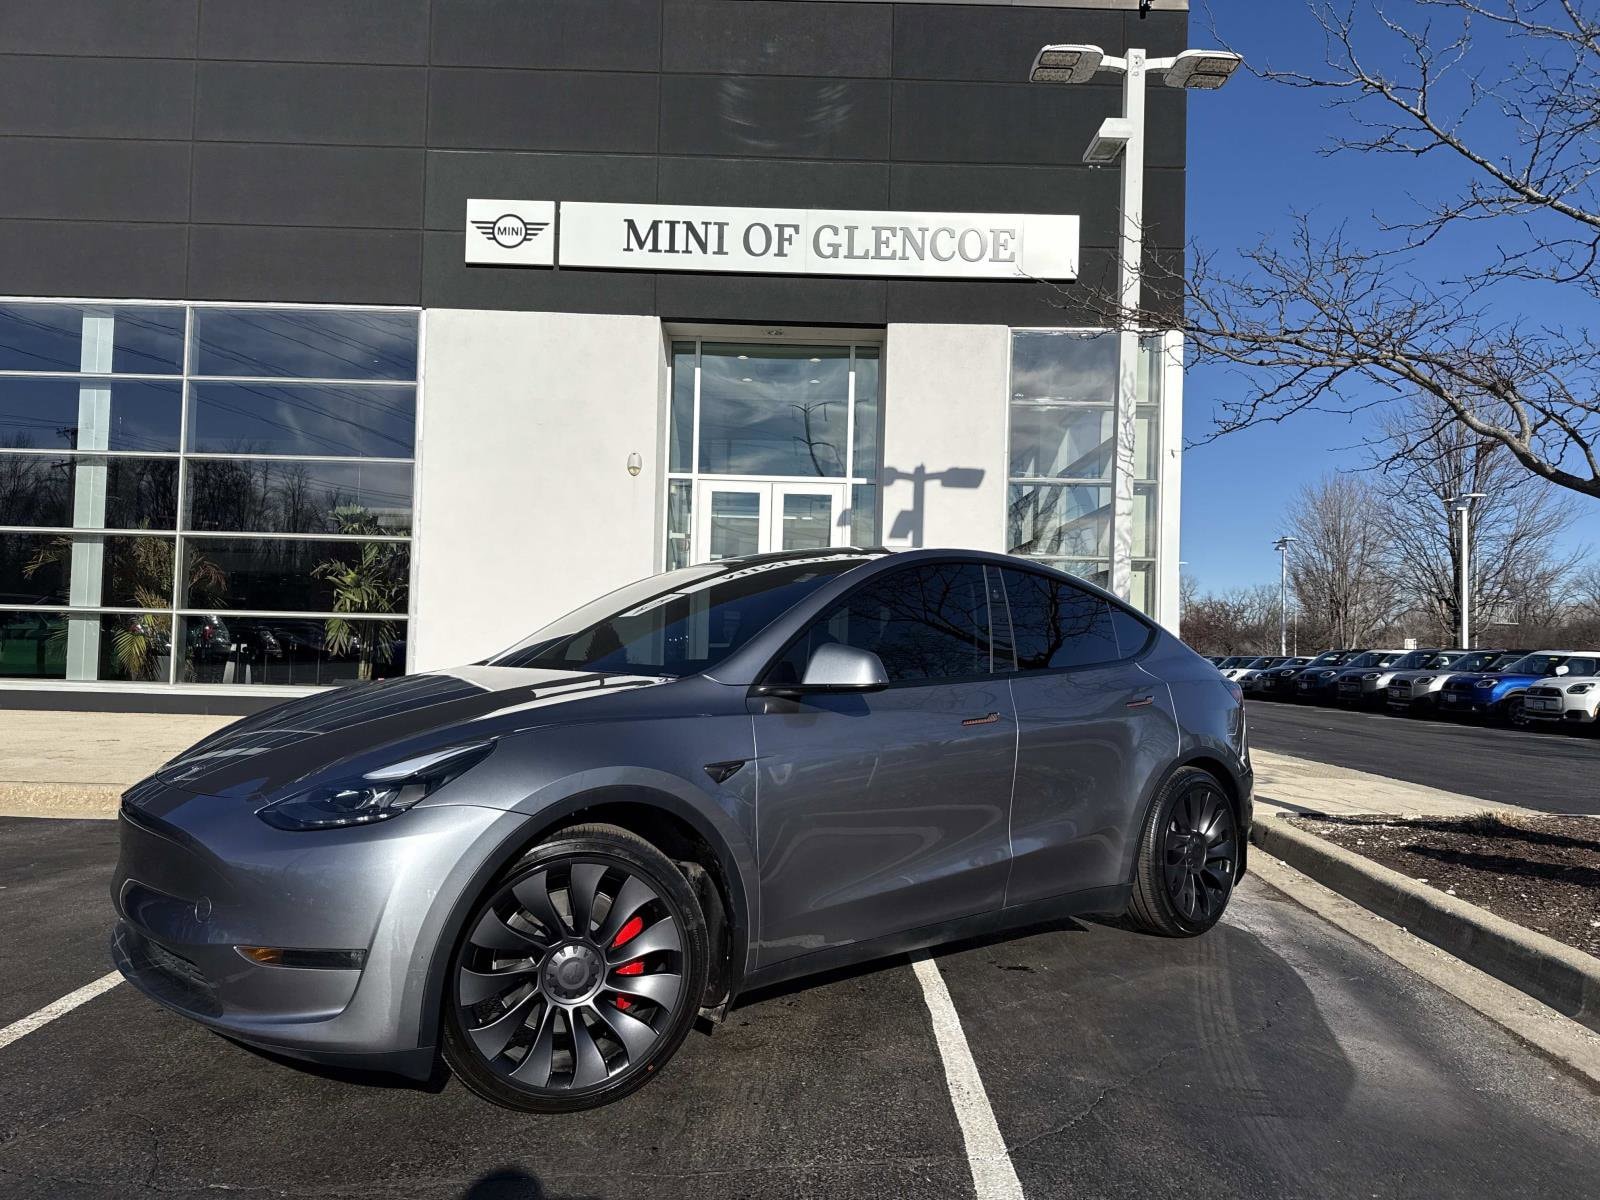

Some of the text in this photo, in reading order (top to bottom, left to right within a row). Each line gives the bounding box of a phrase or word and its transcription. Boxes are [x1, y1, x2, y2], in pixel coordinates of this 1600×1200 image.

[497, 226, 523, 236] MINI
[622, 218, 1016, 262] MINI OF GLENCOE
